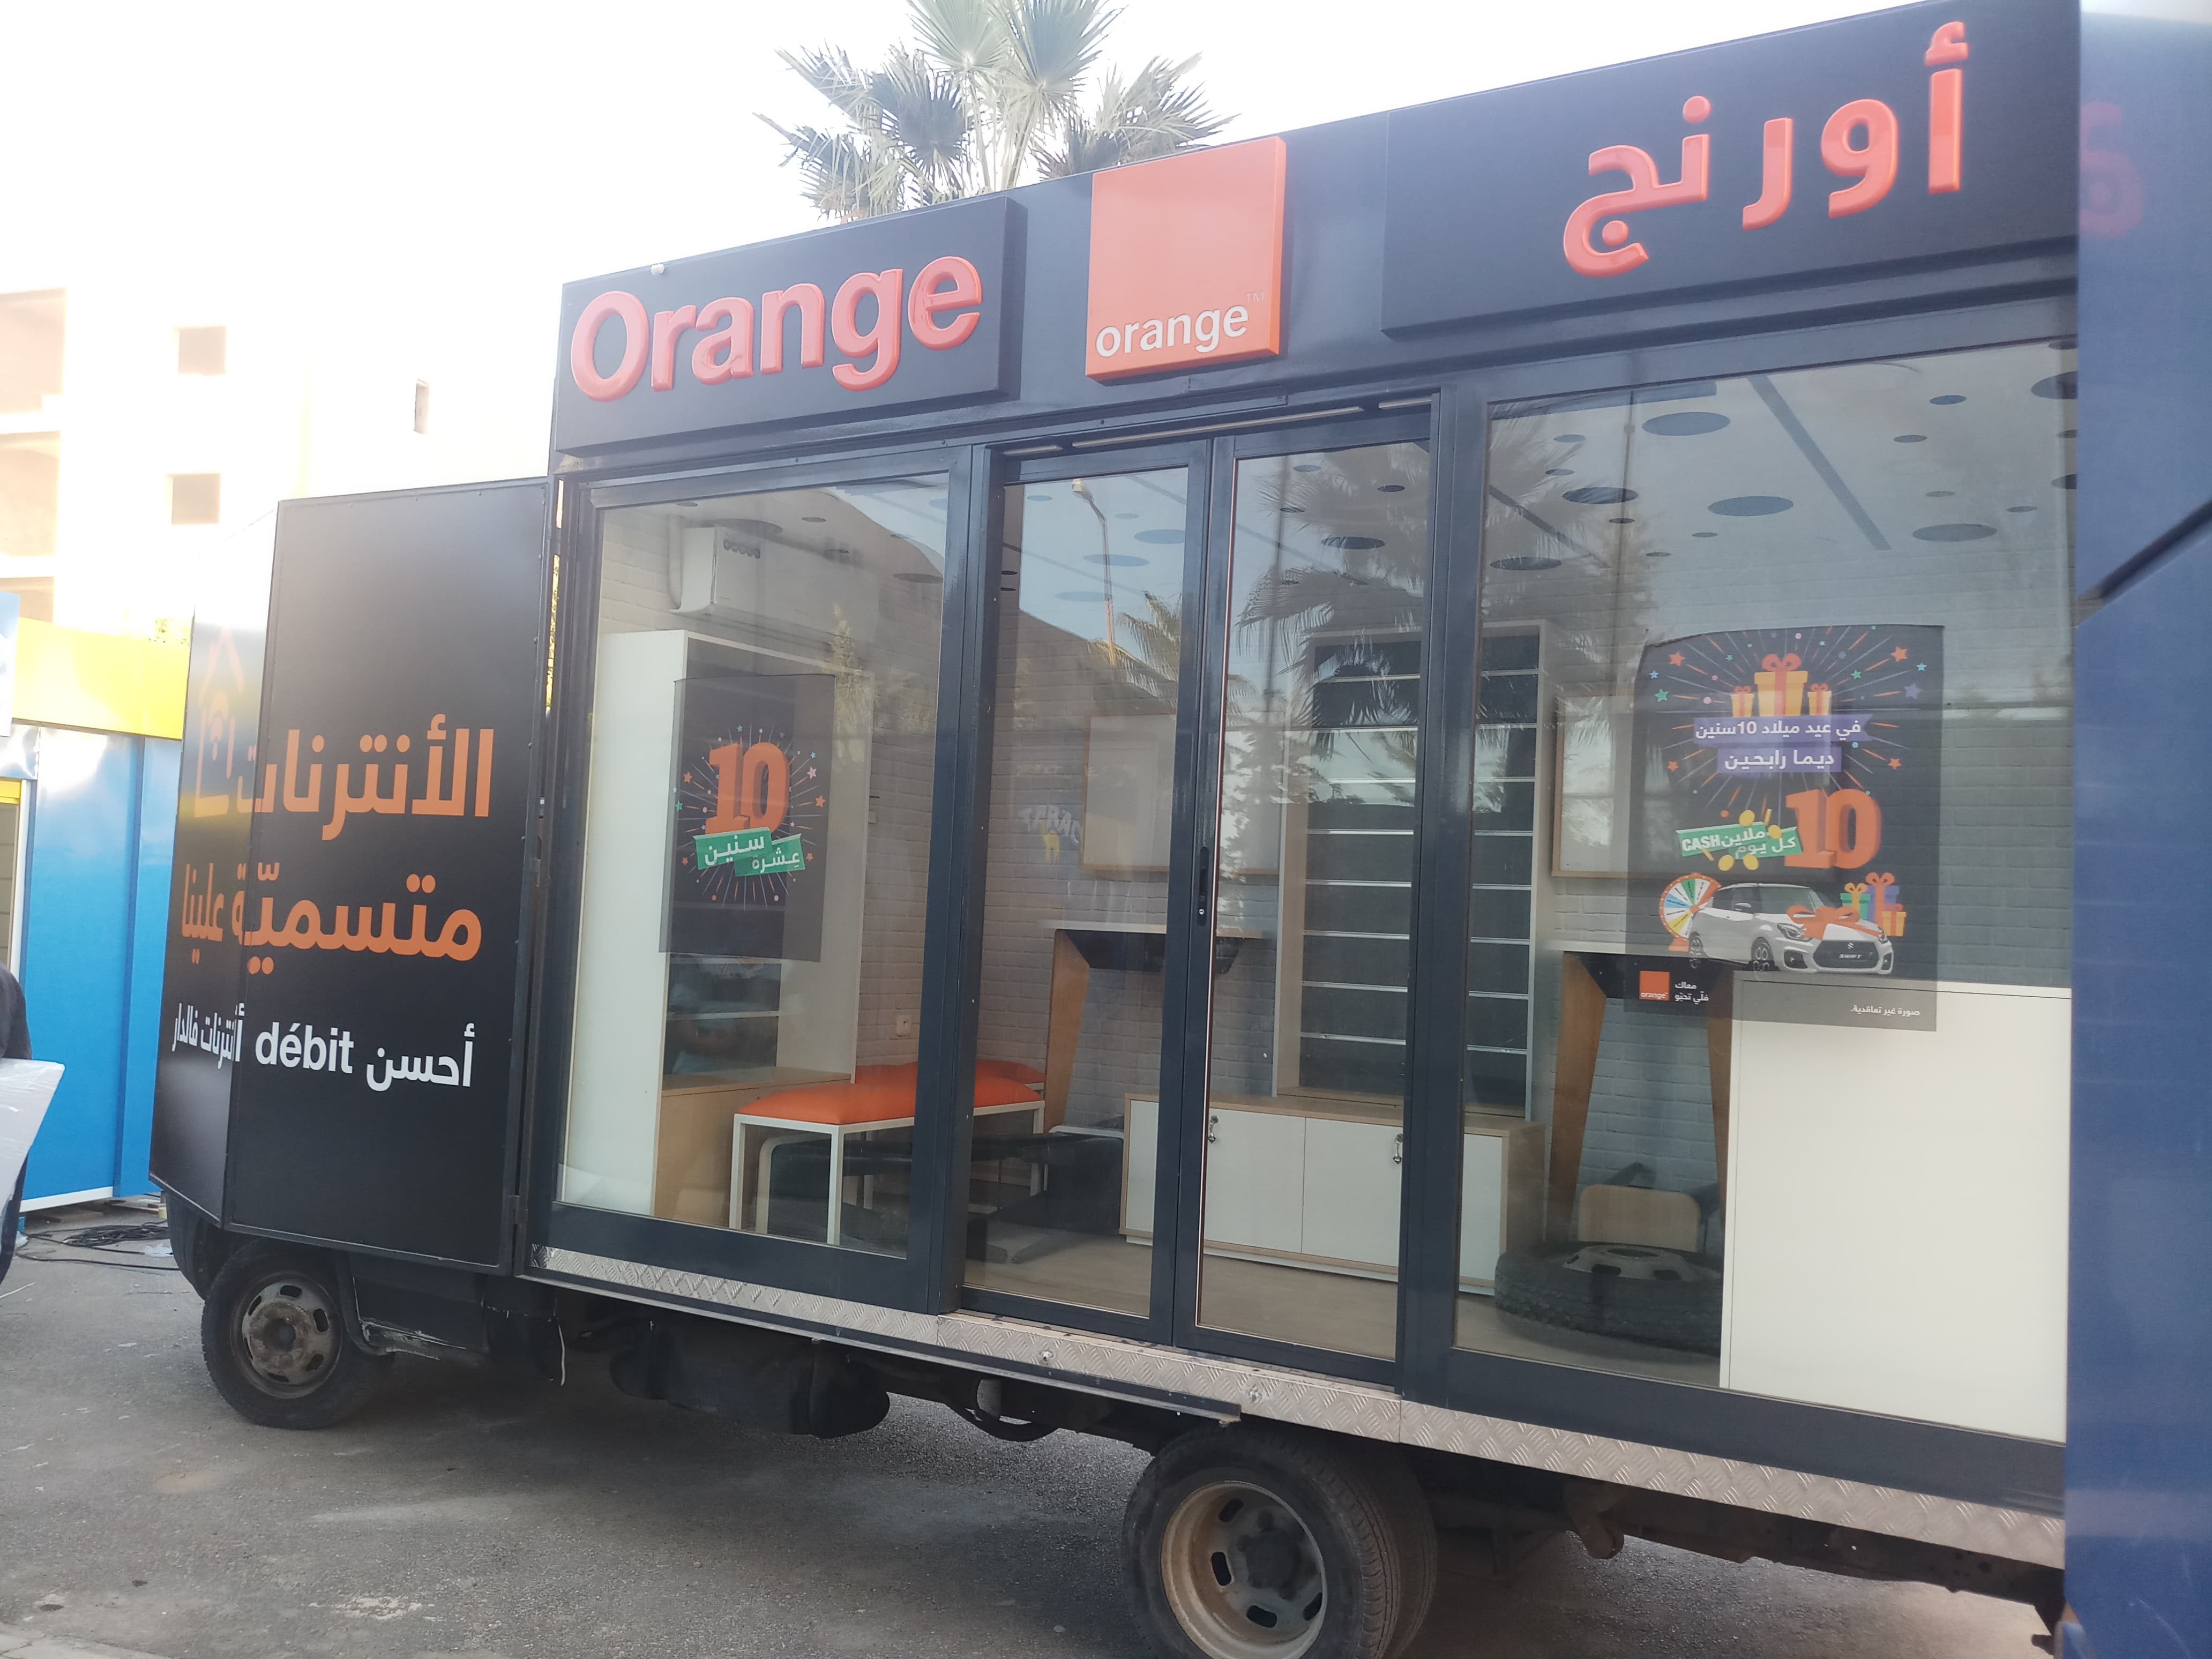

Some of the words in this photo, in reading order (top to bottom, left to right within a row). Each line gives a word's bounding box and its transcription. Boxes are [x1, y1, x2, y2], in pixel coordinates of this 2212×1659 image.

[1563, 21, 1969, 278] أورنج
[570, 255, 983, 402] Orange
[1096, 305, 1249, 357] orange
[1761, 720, 1800, 738] ميلاد
[1805, 723, 1831, 737] عيد
[1836, 720, 1861, 741] في
[1724, 750, 1787, 770] رابحين
[1793, 750, 1835, 769] ديما
[705, 742, 790, 835] 10
[1682, 834, 1721, 851] CASH
[1784, 789, 1881, 870] 10
[705, 835, 765, 866] سنين
[1772, 836, 1796, 853] كل
[1640, 992, 1666, 1000] orange
[256, 1022, 354, 1074] débit
[367, 1022, 475, 1092] أحسن
